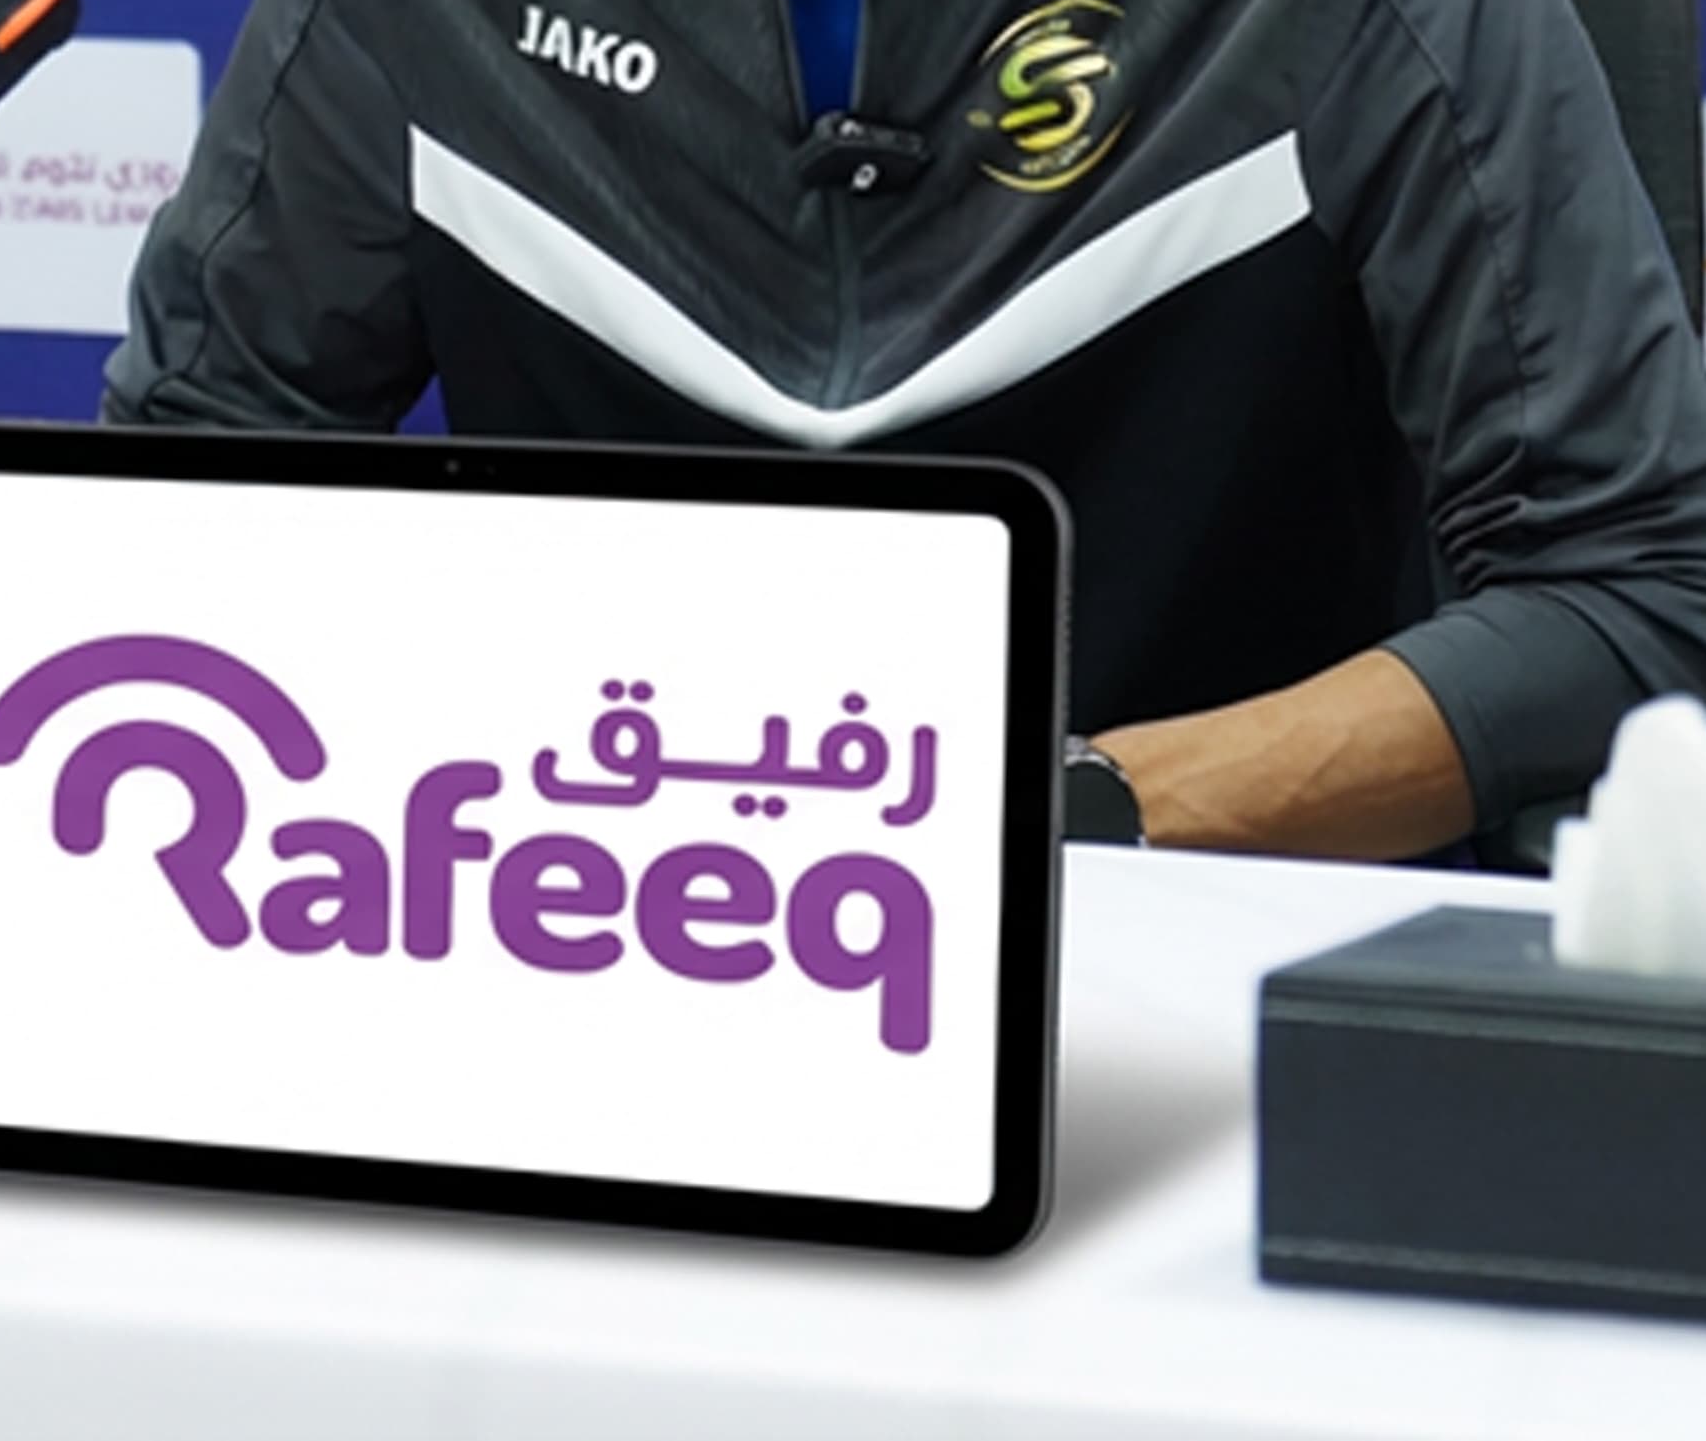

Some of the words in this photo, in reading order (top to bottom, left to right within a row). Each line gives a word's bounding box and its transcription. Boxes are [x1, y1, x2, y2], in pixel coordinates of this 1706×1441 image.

[516, 5, 658, 94] JAKO
[531, 678, 939, 828] رفيق
[51, 719, 938, 1057] Rafeeq
